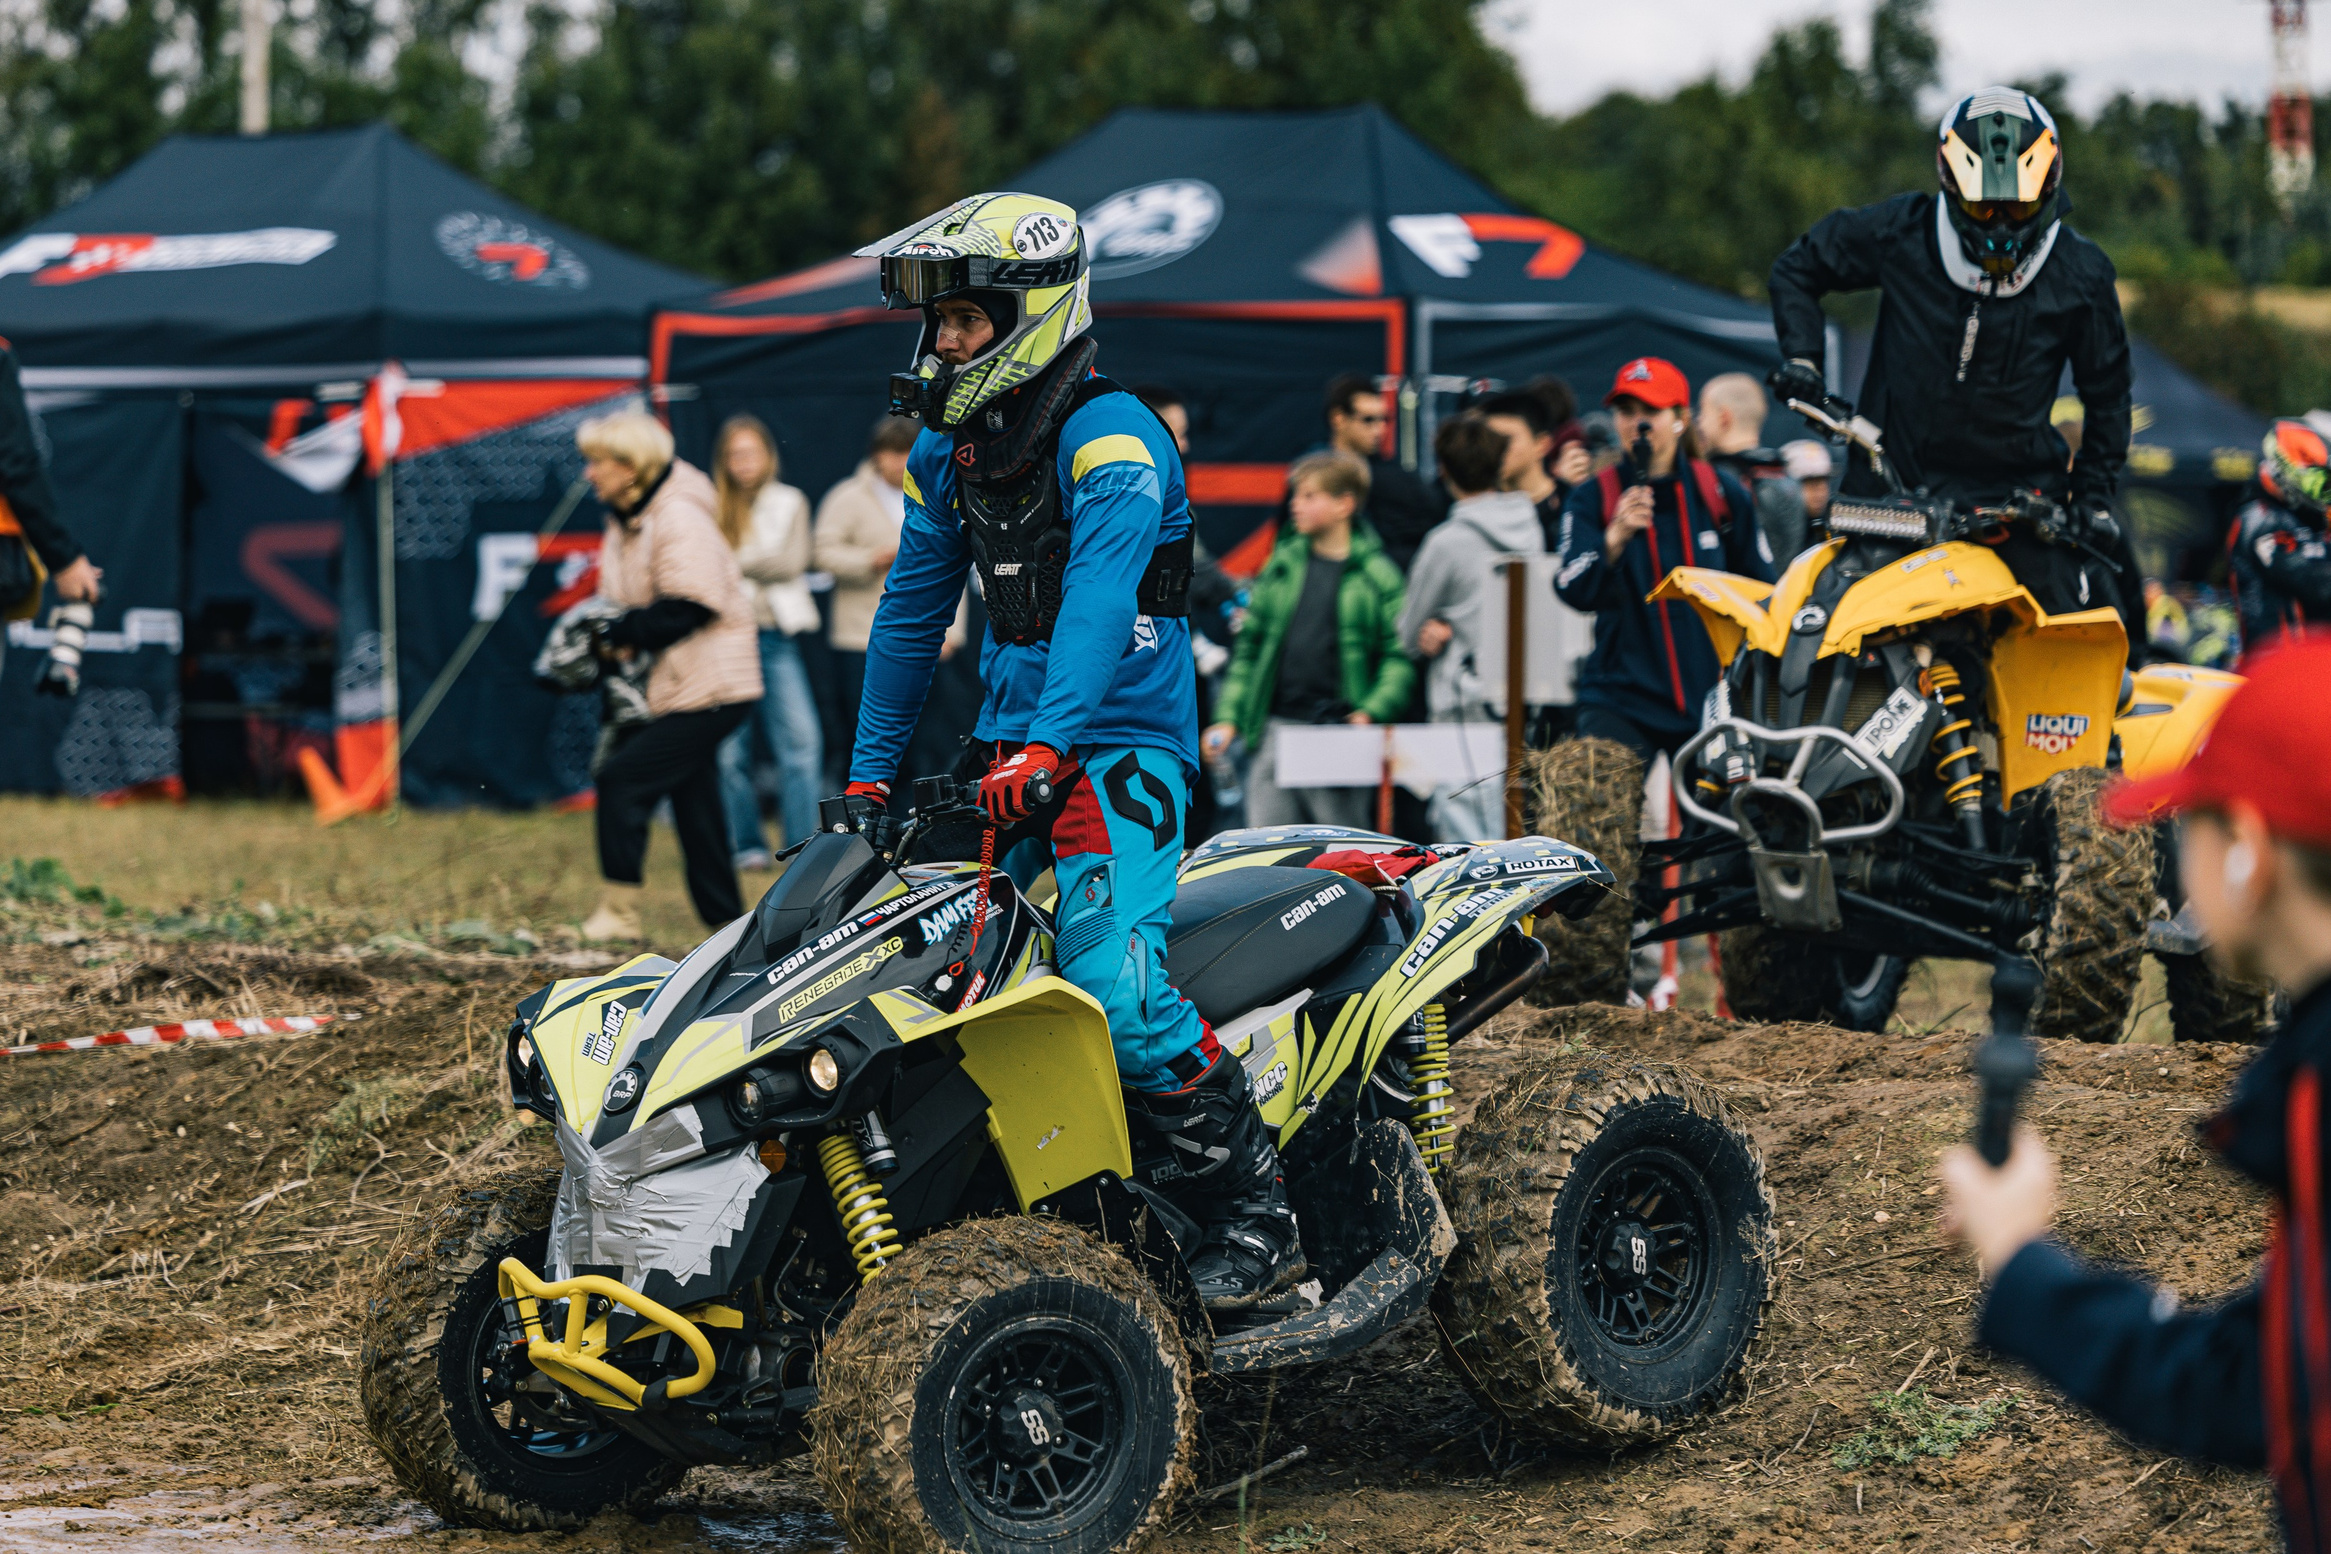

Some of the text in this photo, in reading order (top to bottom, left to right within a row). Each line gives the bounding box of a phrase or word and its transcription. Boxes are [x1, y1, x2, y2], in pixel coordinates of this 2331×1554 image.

[1025, 216, 1059, 252] 113
[991, 255, 1081, 285] LEATT
[994, 563, 1022, 576] LEATT
[1510, 857, 1571, 871] ROTAX
[1280, 884, 1347, 931] can-am
[1468, 891, 1515, 919] TEAM
[1400, 887, 1506, 978] can-am
[767, 922, 860, 985] can-am
[780, 960, 863, 1021] RENEGADE
[582, 1032, 597, 1057] TEAM
[592, 1000, 628, 1066] can-am
[612, 1089, 632, 1099] BRP
[1021, 1409, 1050, 1446] SS
